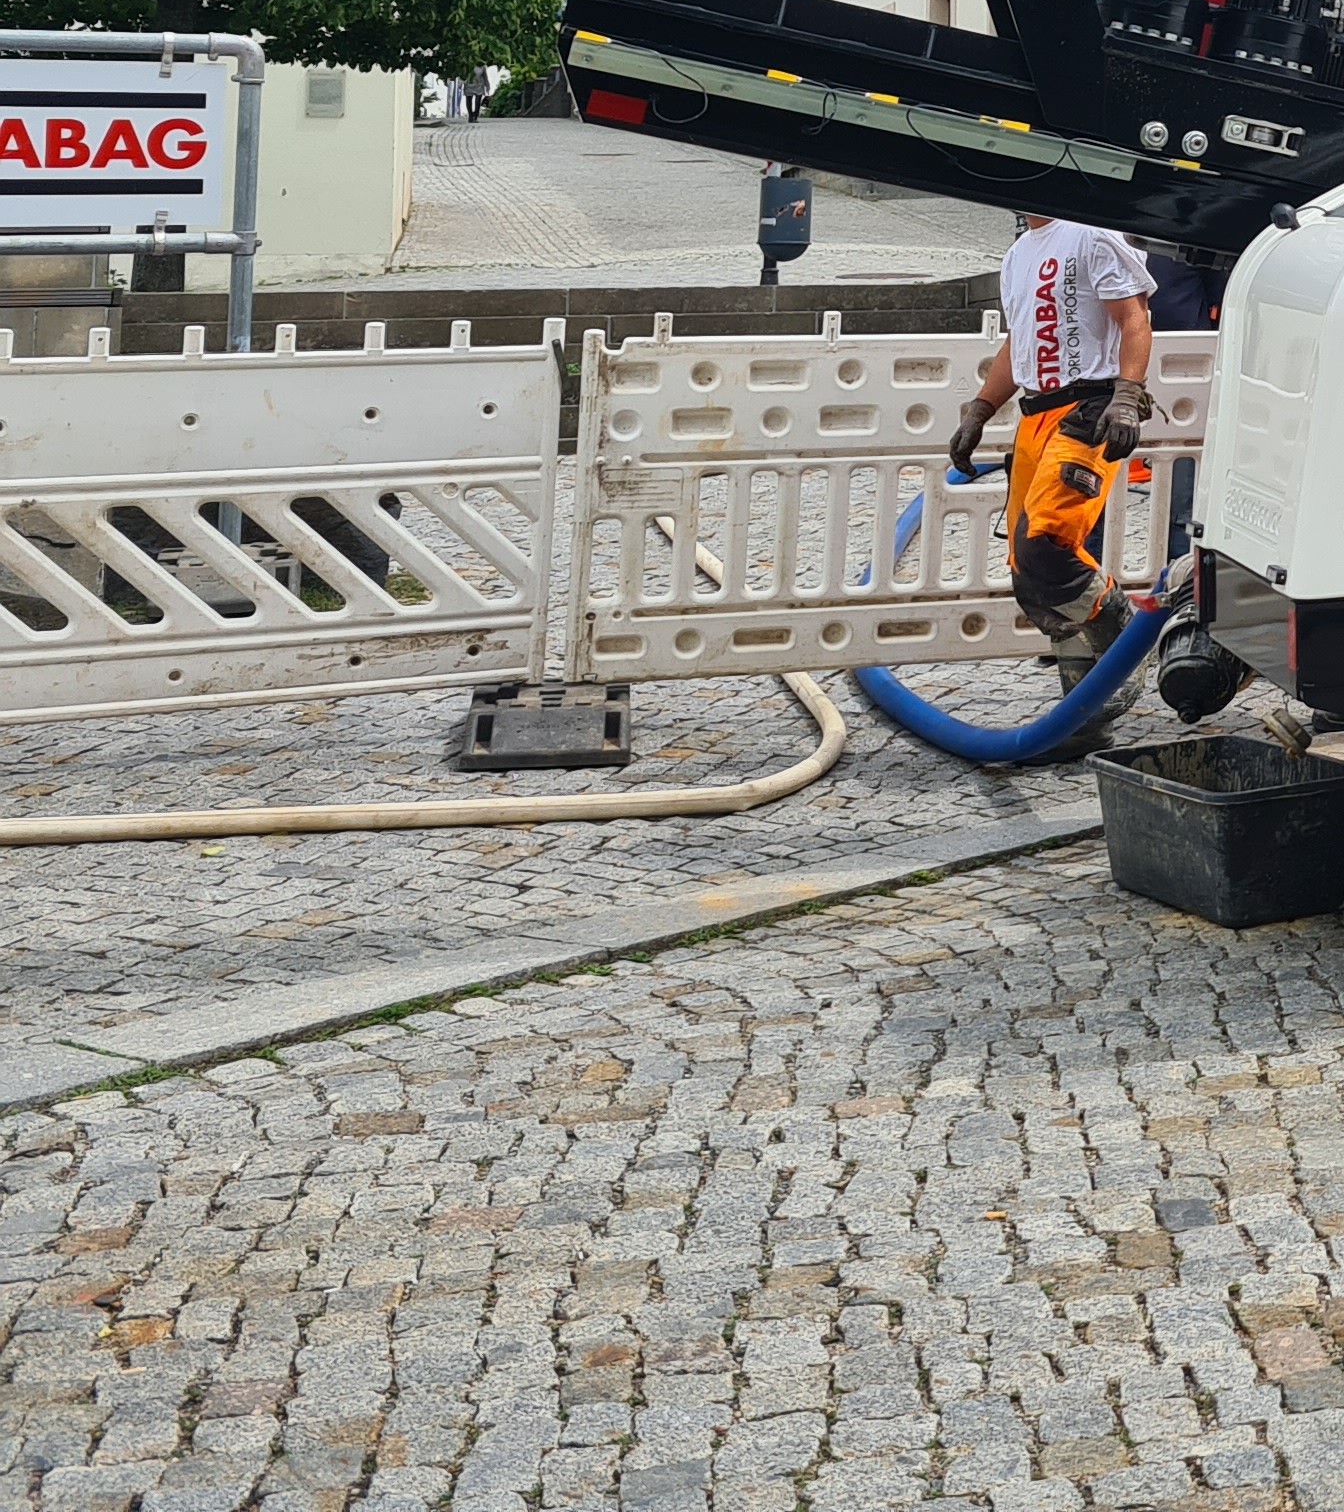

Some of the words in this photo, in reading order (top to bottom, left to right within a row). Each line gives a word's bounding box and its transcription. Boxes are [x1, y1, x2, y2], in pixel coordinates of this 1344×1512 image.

[1064, 257, 1078, 324] PROGRESS
[1036, 257, 1061, 393] STRABAG
[1066, 327, 1080, 348] ON
[1067, 351, 1081, 385] ORK
